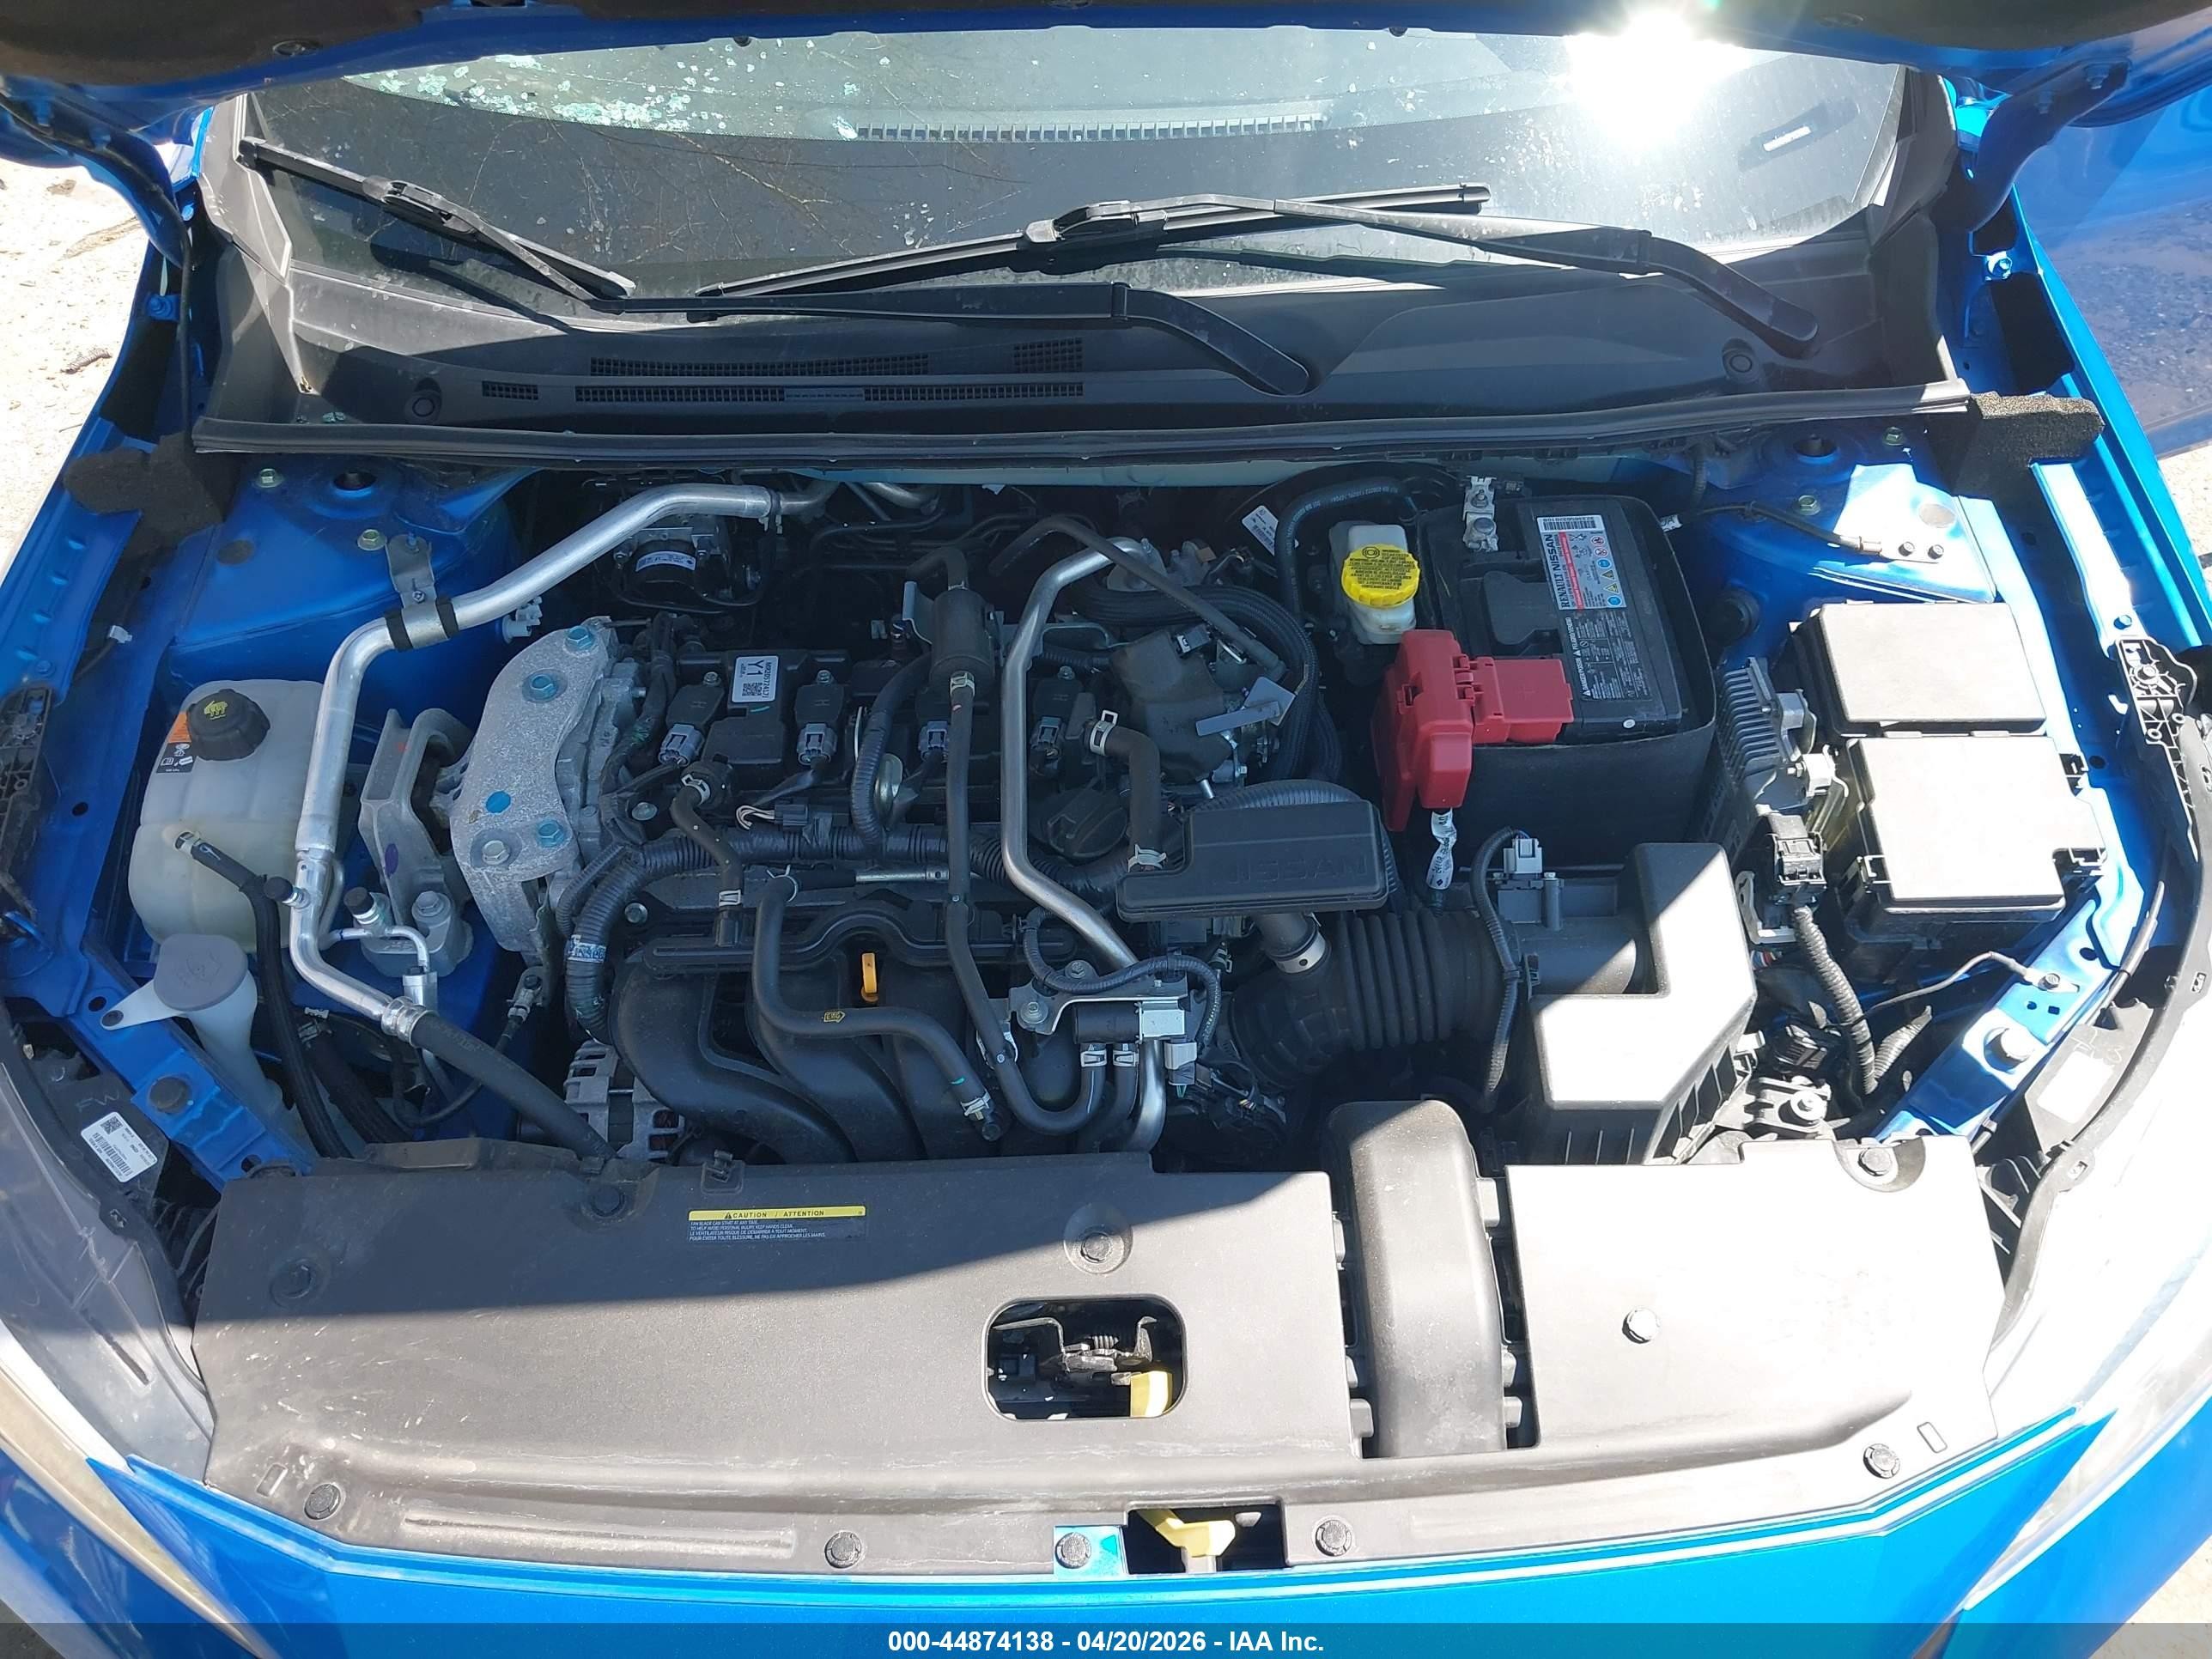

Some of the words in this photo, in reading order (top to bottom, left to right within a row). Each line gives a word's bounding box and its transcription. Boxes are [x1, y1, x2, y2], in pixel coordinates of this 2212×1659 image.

[1544, 534, 1561, 571] NISSAN
[1553, 574, 1571, 608] RENAULT
[747, 659, 764, 675] Y1
